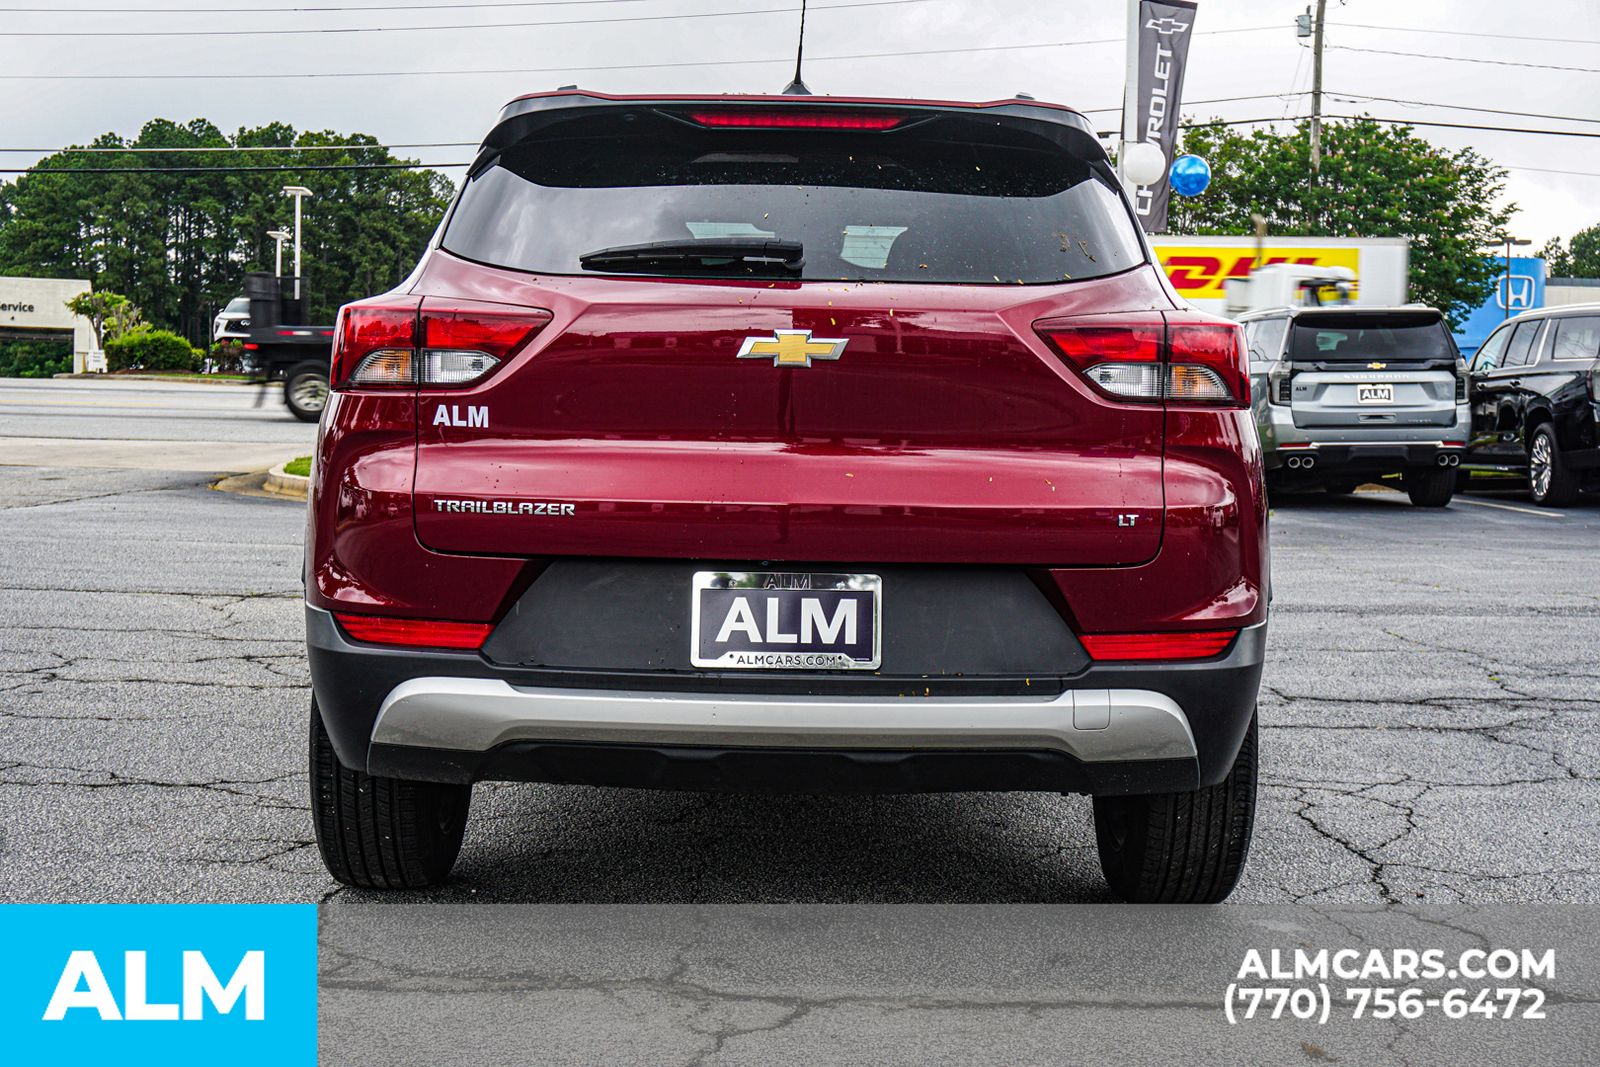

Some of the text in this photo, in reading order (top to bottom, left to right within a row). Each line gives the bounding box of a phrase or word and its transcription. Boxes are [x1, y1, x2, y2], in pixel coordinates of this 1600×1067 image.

[0, 302, 35, 313] ervice
[1362, 389, 1389, 399] ALM
[432, 405, 489, 428] ALM
[433, 499, 575, 516] TRAILBLAZER
[1118, 514, 1139, 527] LT
[715, 597, 858, 645] ALM
[736, 655, 837, 666] ALMCARS.COM
